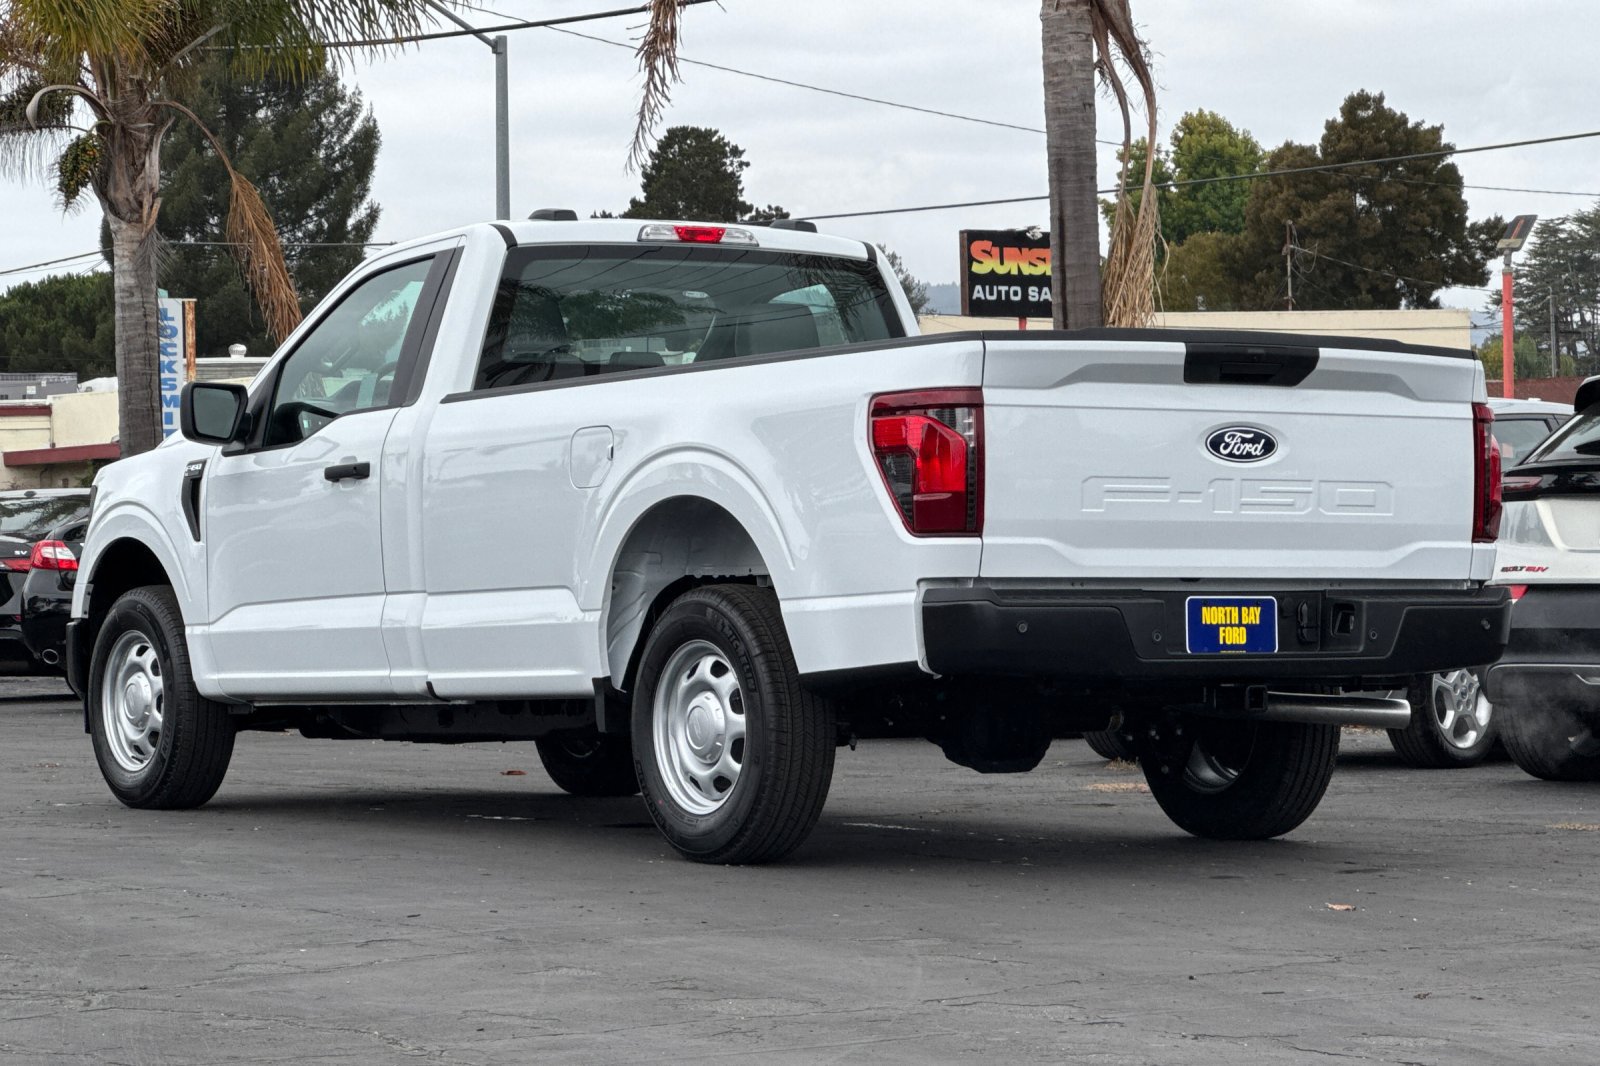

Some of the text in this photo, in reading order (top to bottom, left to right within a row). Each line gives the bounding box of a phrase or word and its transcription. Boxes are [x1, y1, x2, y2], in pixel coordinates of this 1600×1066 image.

[972, 284, 1022, 301] AUTO
[1220, 431, 1265, 455] Ford
[1081, 475, 1394, 516] F-150
[1202, 606, 1261, 625] NORTH BAY
[1219, 626, 1247, 645] FORD
